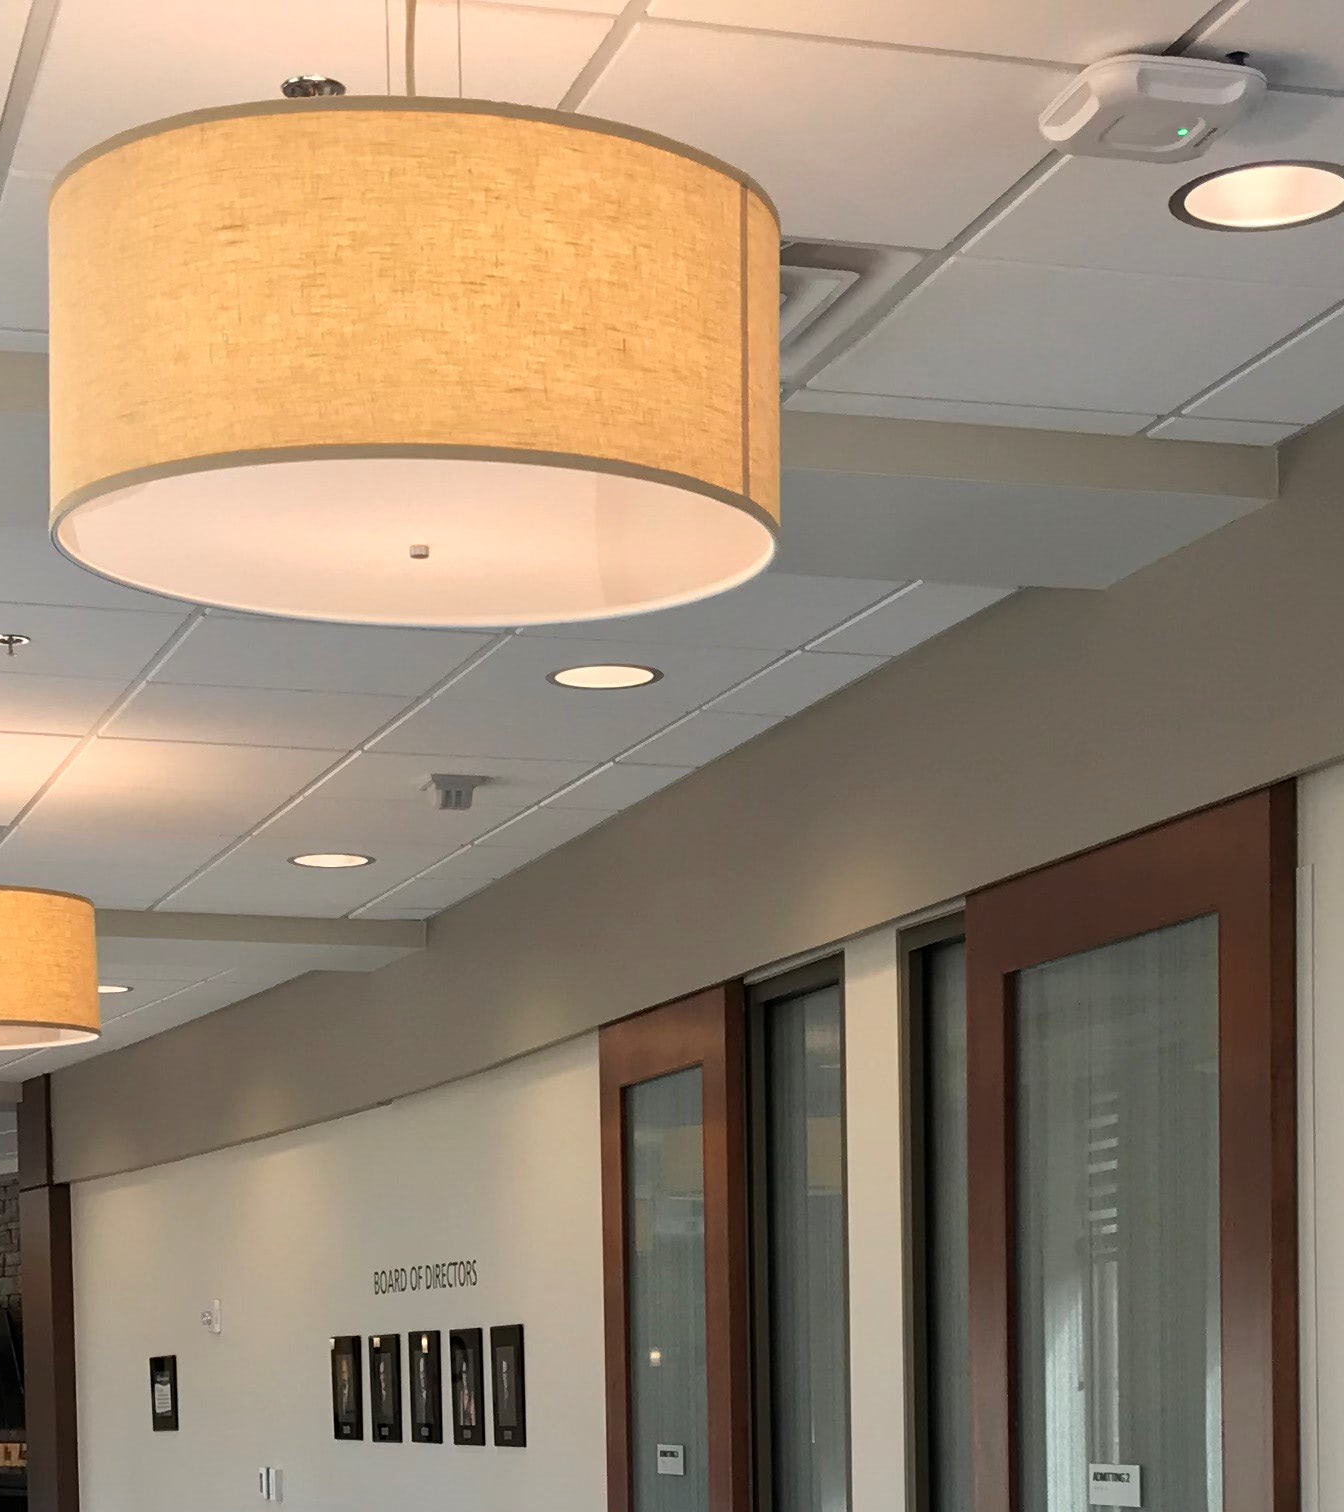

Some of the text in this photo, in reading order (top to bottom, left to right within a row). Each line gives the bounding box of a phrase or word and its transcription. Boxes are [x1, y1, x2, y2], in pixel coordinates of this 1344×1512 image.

[374, 1259, 478, 1295] BOARD OF DIRECTORS
[1092, 1471, 1131, 1483] ADMITTING 2
